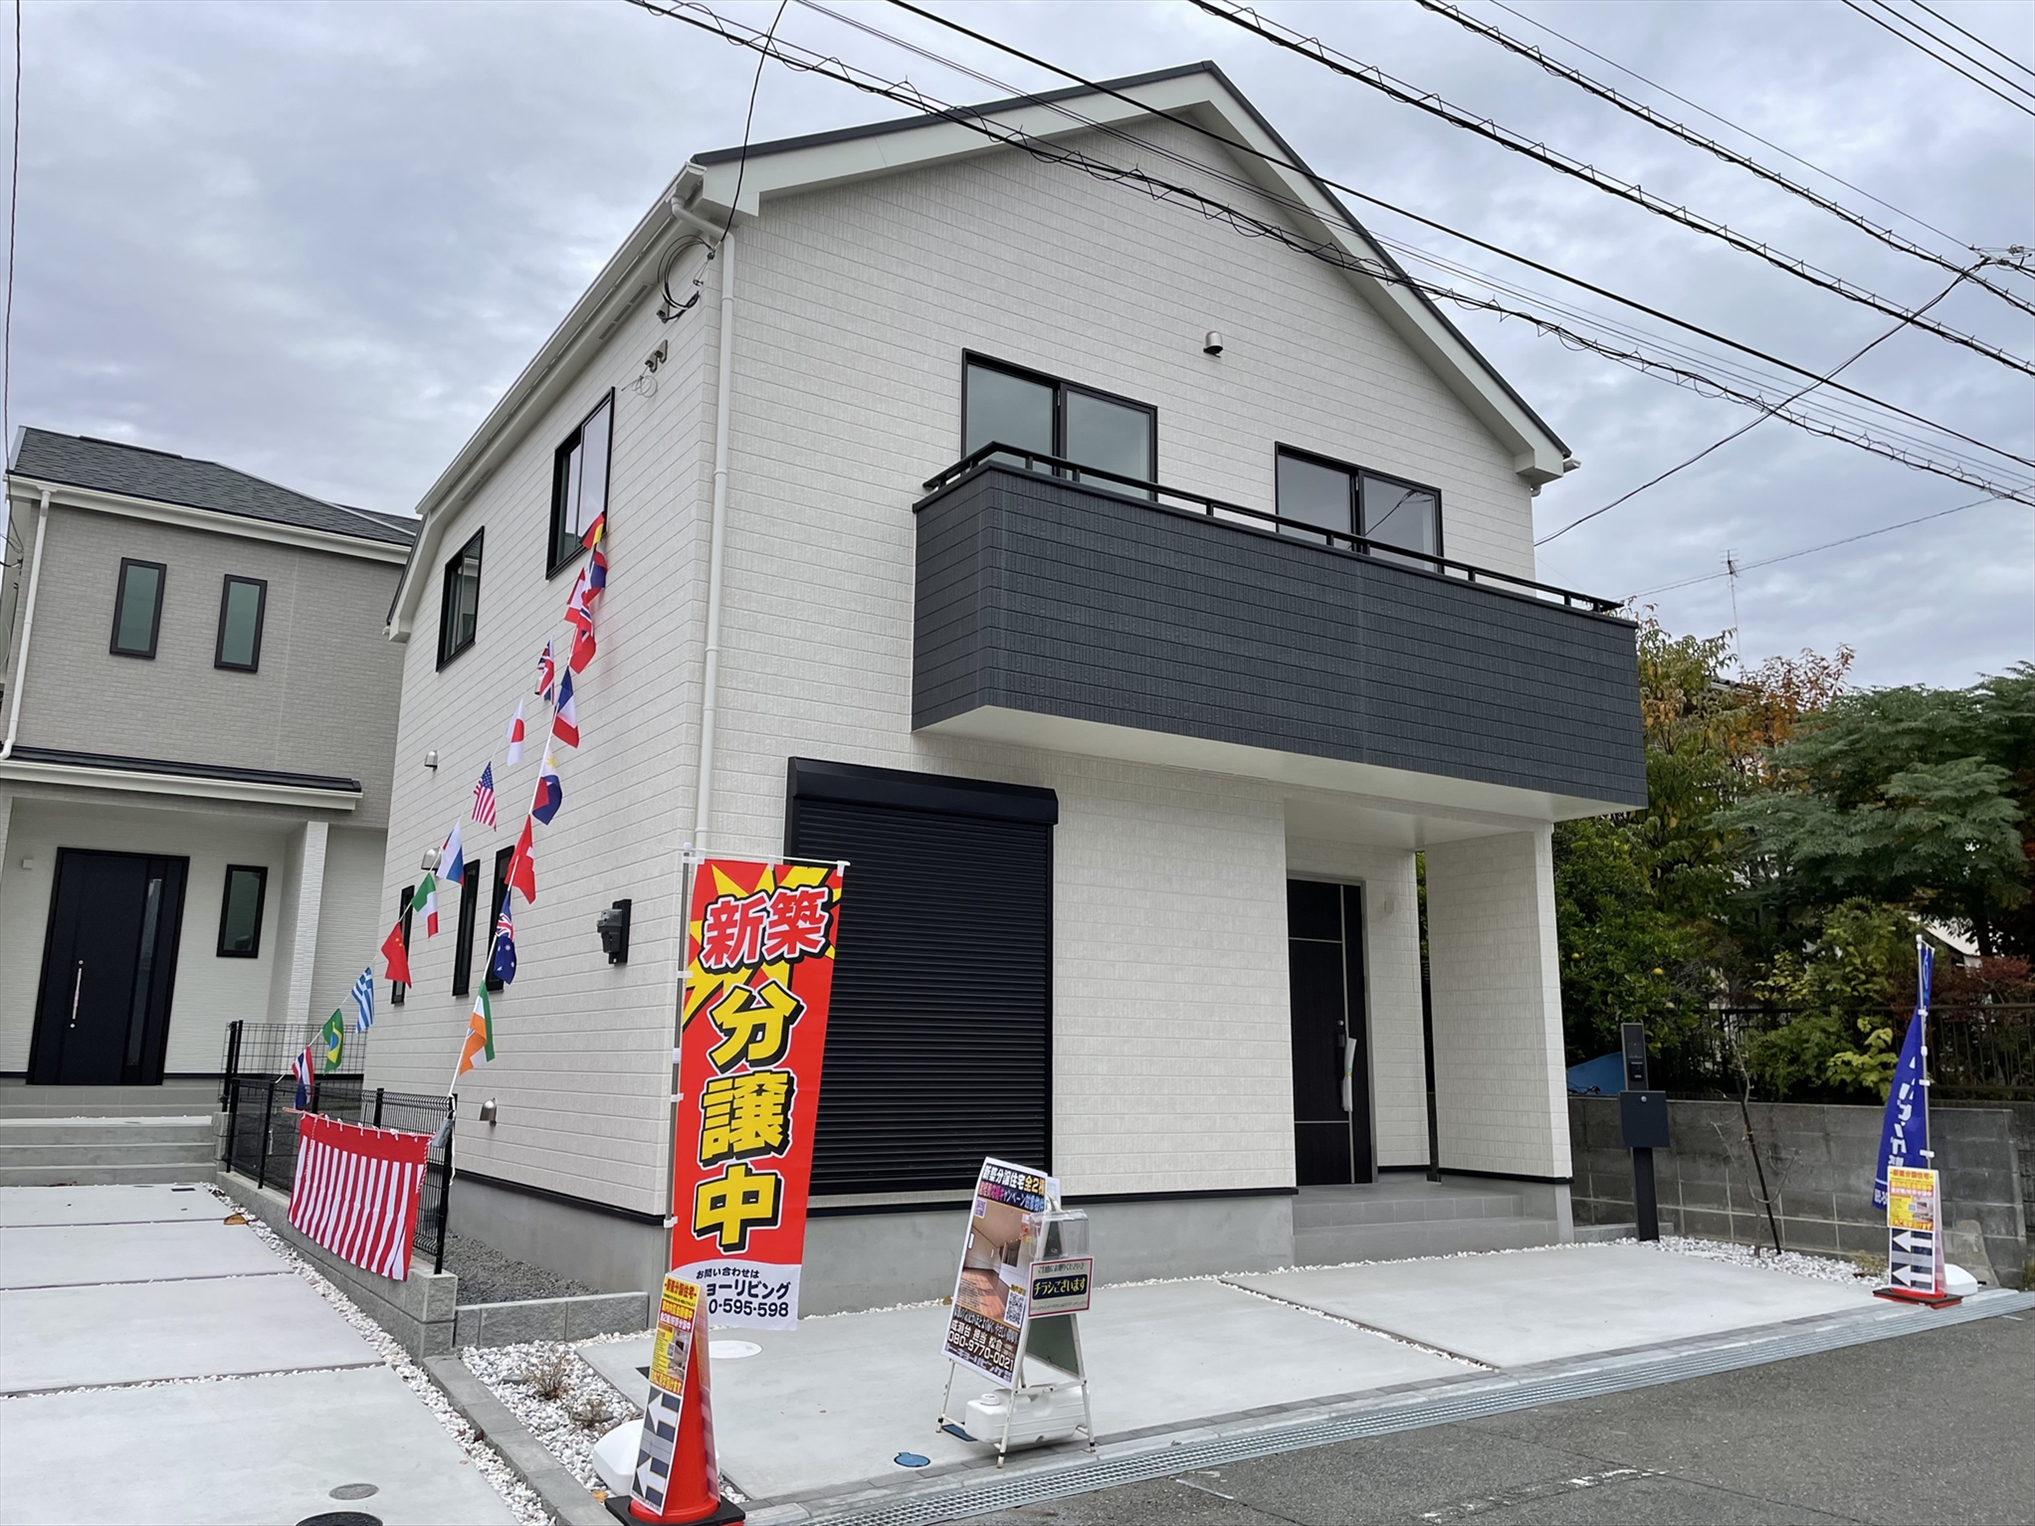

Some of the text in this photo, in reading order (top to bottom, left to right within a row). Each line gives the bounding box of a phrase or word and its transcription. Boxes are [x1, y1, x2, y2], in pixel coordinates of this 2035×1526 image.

[700, 887, 829, 970] 新築
[693, 979, 806, 1253] 分譲中
[696, 1267, 760, 1280] お問い合わせは
[1034, 1277, 1086, 1297] チラシございます
[706, 1279, 791, 1300] ョーリビング
[948, 1330, 1014, 1371] 080-9770-0021
